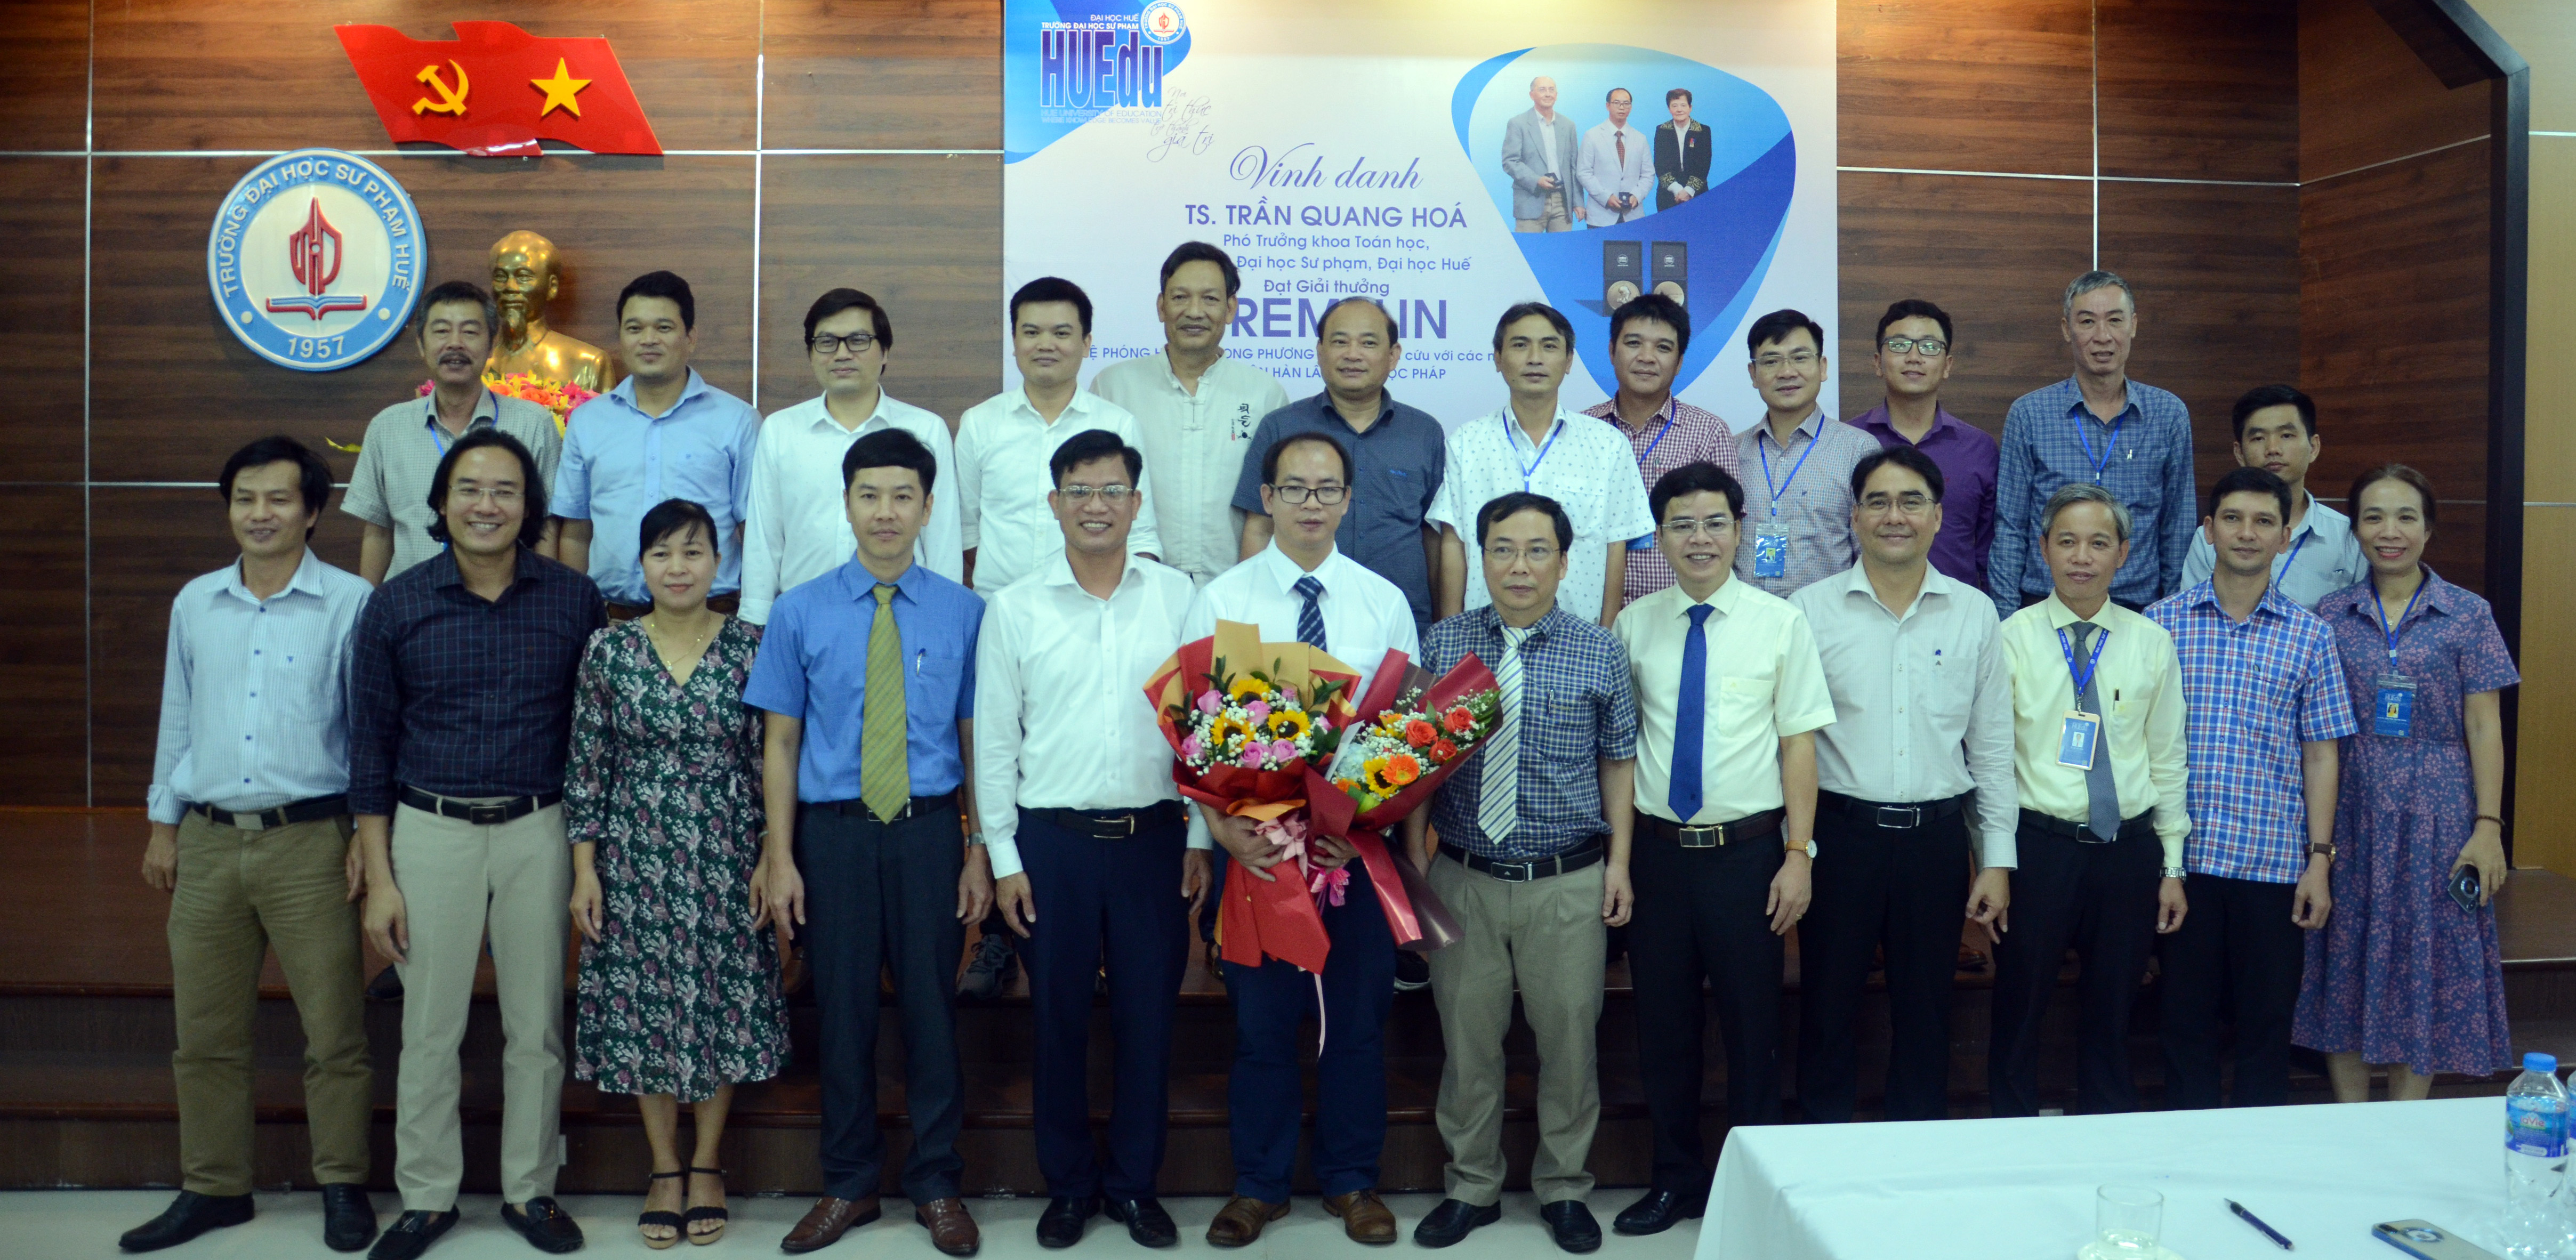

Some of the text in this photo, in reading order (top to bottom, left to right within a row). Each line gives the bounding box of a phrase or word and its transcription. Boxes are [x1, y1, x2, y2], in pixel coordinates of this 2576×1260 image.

[1105, 14, 1122, 23] HỌC
[1124, 13, 1139, 21] HUẾ
[1041, 29, 1163, 108] HUEdu
[1229, 142, 1424, 190] Vinh danh
[1185, 196, 1468, 228] TS. TRẦN QUANG HOÁ
[218, 160, 410, 297] TRƯỜNG ĐẠI HỌC SƯ PHẠM HUẾ
[1223, 233, 1430, 252] Phó Trưởng khoa Toán học,
[1237, 256, 1472, 273] Đại học Sư phạm, Đại học Huế
[1263, 277, 1389, 296] Đạt Giải thưởng
[288, 336, 344, 358] 1957
[1103, 344, 1150, 358] PHÓNG
[1258, 347, 1315, 359] PHƯƠNG
[1405, 350, 1430, 360] cứu
[1434, 350, 1453, 361] với
[1458, 350, 1483, 361] các
[1273, 364, 1301, 377] HÀN
[1306, 365, 1321, 377] LÂ
[1413, 366, 1446, 379] PHÁP
